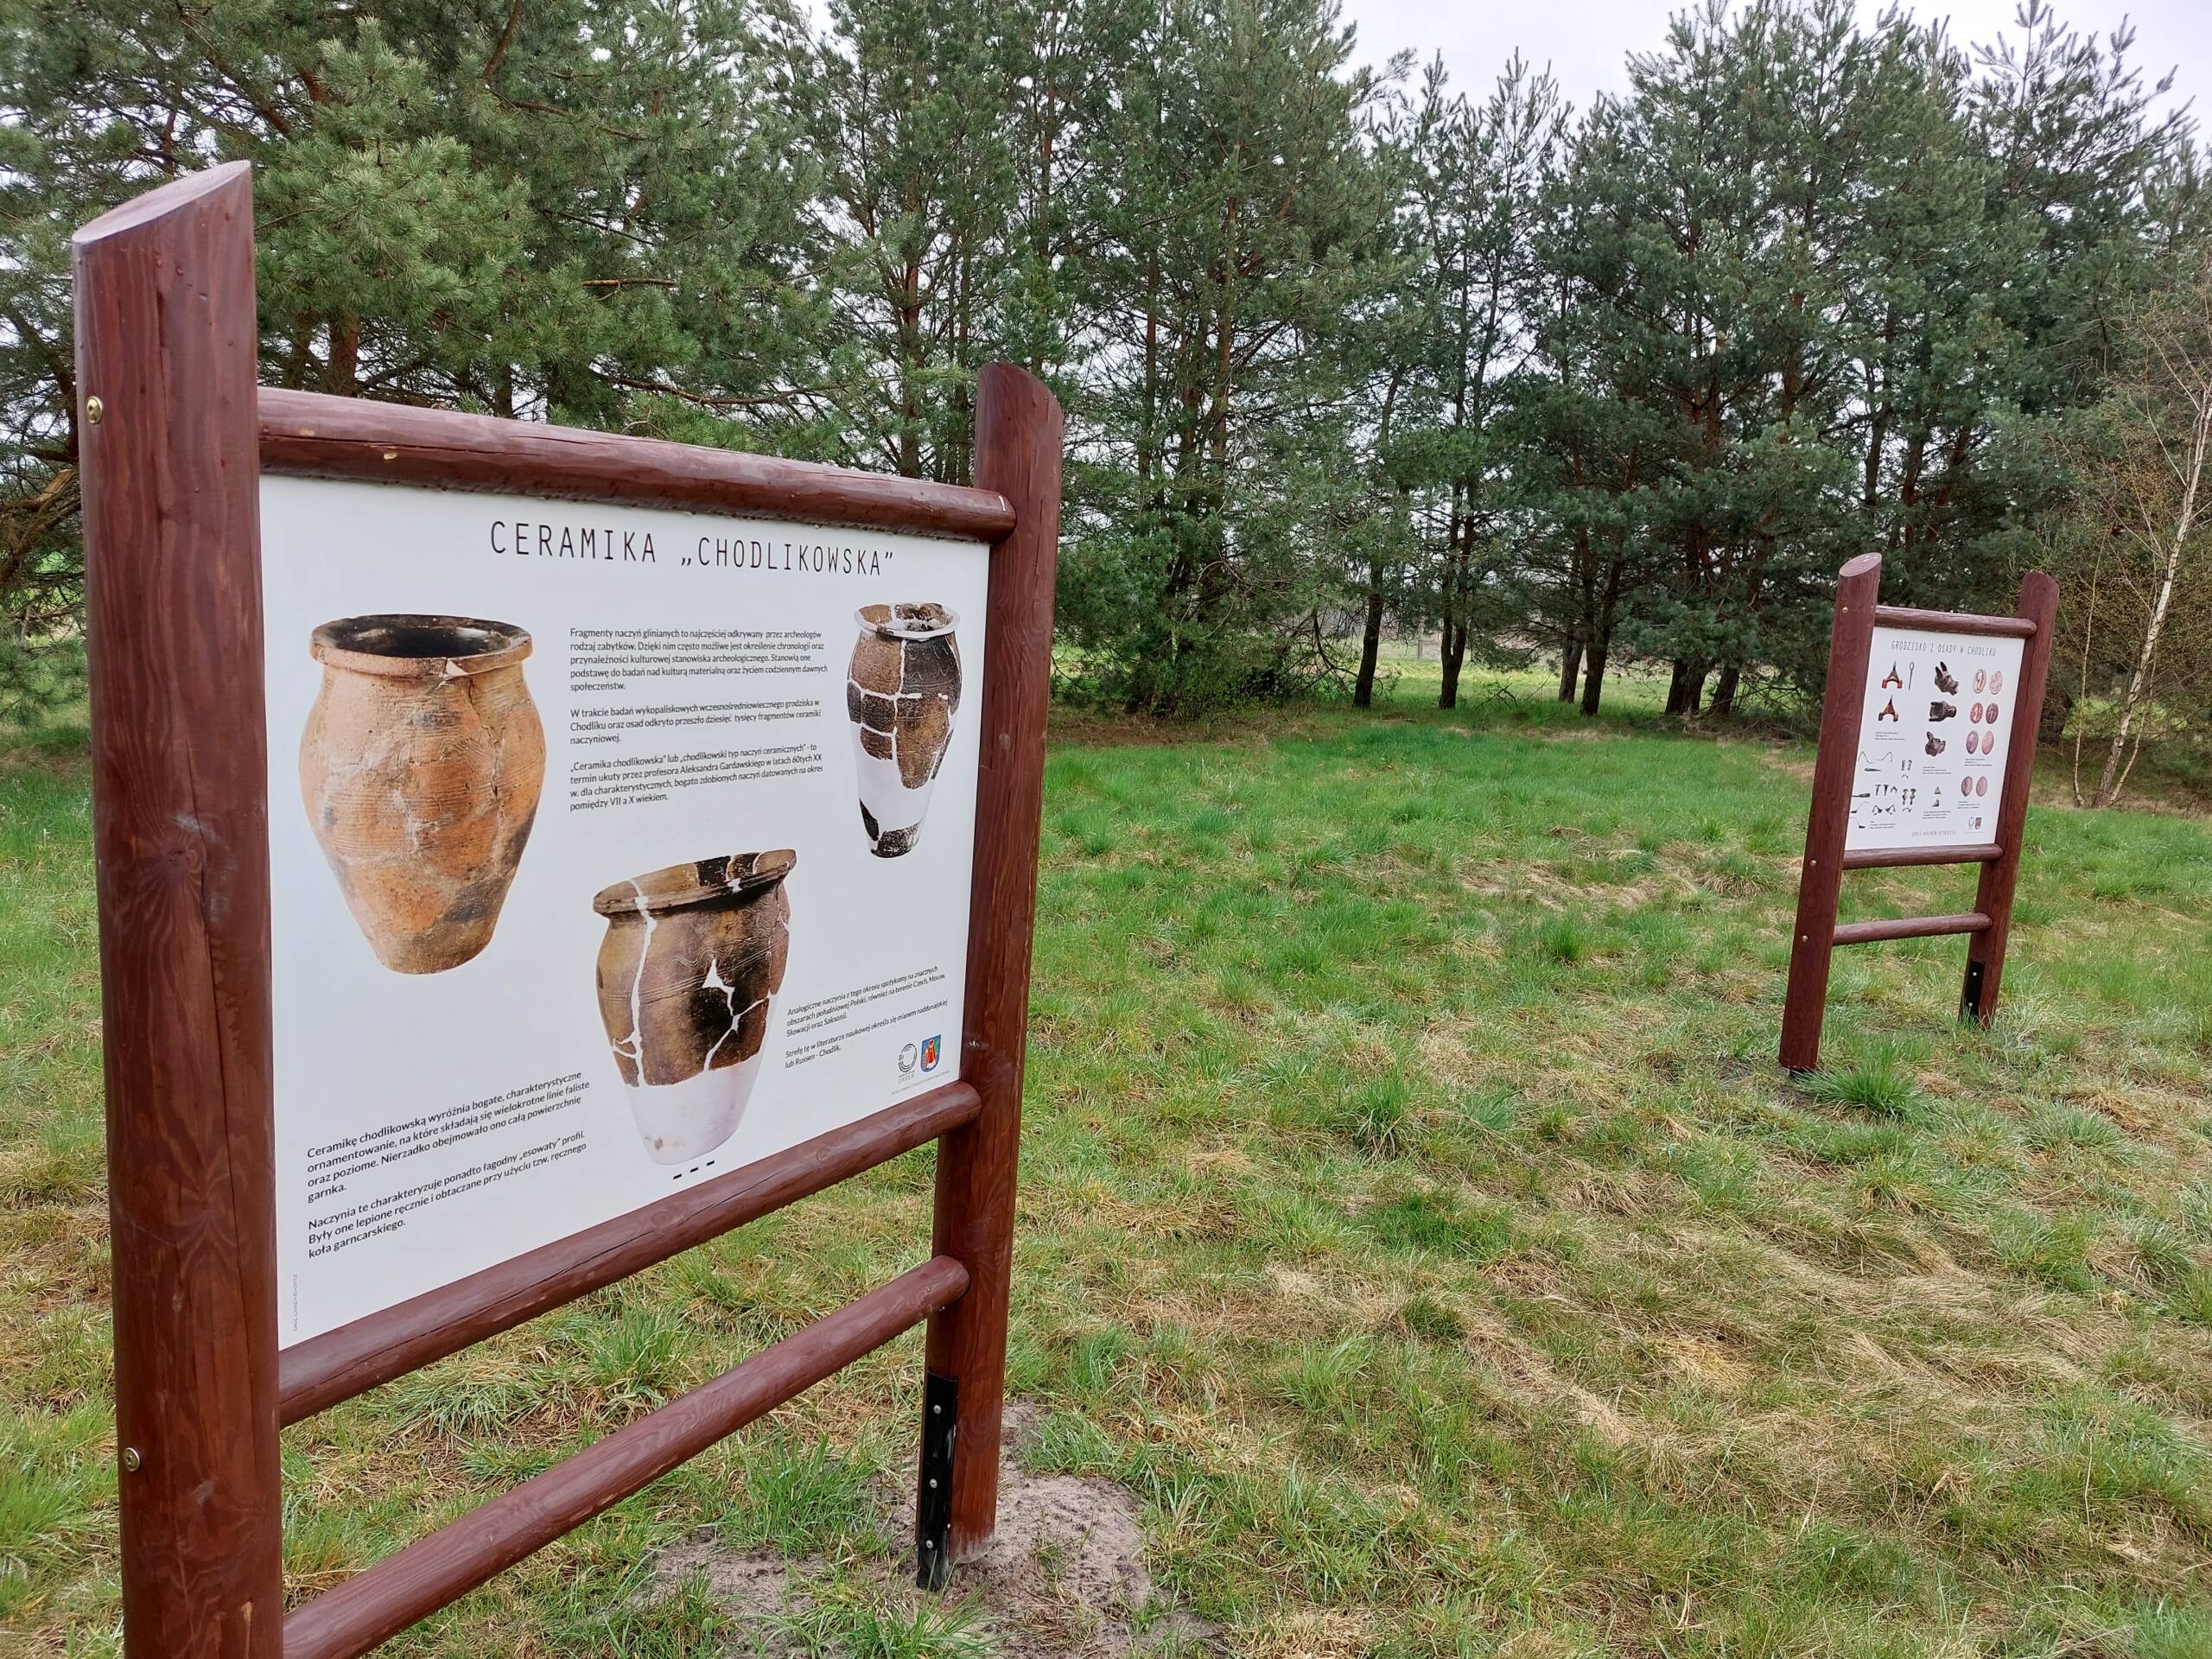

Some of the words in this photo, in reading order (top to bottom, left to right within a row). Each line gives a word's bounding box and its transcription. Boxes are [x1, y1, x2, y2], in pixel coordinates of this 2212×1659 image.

[491, 520, 656, 563] CERAMIKA
[681, 537, 893, 576] „CHODLIKOWSKA”
[570, 627, 613, 639] Fragmenty
[614, 628, 642, 639] naczyń
[642, 628, 680, 639] glinianych
[690, 629, 727, 639] najczęściej
[727, 629, 764, 639] odkrywany
[783, 630, 823, 640] archeologów
[569, 641, 596, 652] rodzaj
[597, 641, 636, 652] zabytków.
[638, 641, 661, 652] Dzięki
[662, 641, 677, 651] nim
[677, 642, 700, 652] często
[701, 641, 729, 651] możliwe
[729, 641, 742, 652] jest
[742, 641, 777, 651] określenie
[777, 641, 811, 652] chronologii
[1891, 640, 1927, 652] GRODZISKO
[570, 654, 629, 666] przynależności
[630, 654, 671, 664] kulturowej
[671, 653, 711, 664] stanowiska
[711, 653, 770, 664] archeologicznego.
[771, 653, 799, 663] Stanowią
[569, 669, 609, 680] podstawę
[610, 667, 621, 677] do
[621, 667, 645, 677] badań
[646, 667, 661, 677] nad
[661, 666, 688, 677] kulturą
[688, 665, 726, 676] materialną
[741, 665, 765, 676] życiem
[765, 665, 802, 674] codziennym
[802, 664, 829, 674] dawnych
[569, 709, 581, 718] W
[582, 708, 609, 718] trakcie
[610, 706, 634, 716] badań
[635, 703, 699, 716] wykopaliskowych
[699, 701, 785, 712] wczesnośredniowiecznego
[785, 698, 814, 709] grodziska
[569, 721, 607, 732] Chodliku
[626, 719, 644, 728] osad
[645, 717, 674, 728] odkryto
[675, 715, 705, 727] przeszło
[705, 714, 732, 724] dziesięć
[734, 713, 758, 723] tysięcy
[758, 710, 796, 721] fragmentów
[796, 709, 822, 718] ceramiki
[570, 733, 621, 746] naczyniowej.
[667, 753, 679, 763] lub
[740, 747, 762, 757] naczyń
[569, 773, 597, 785] termin
[598, 772, 621, 782] ukuty
[622, 772, 643, 781] przez
[644, 767, 679, 779] profesora
[679, 762, 719, 774] Aleksandra
[719, 760, 766, 771] Gardawskiego
[772, 756, 791, 766] latach
[791, 754, 813, 764] 60tych
[580, 787, 593, 797] dla
[594, 779, 673, 796] charakterystycznych,
[674, 778, 699, 788] bogato
[699, 772, 738, 785] zdobionych
[738, 770, 761, 780] naczyń
[760, 766, 798, 779] datowanych
[806, 765, 823, 773] okres
[569, 798, 609, 812] pomiędzy
[609, 797, 621, 806] VII
[635, 793, 669, 803] wiekiem.
[307, 1137, 358, 1158] Ceramikę
[359, 1117, 427, 1143] chodlikowską
[428, 1103, 471, 1122] wyróżnia
[505, 1072, 582, 1100] charakterystyczne
[307, 1140, 397, 1173] ornamentowanie,
[399, 1135, 411, 1146] na
[413, 1128, 439, 1141] które
[440, 1115, 479, 1133] składają
[480, 1110, 493, 1122] się
[493, 1096, 545, 1116] wielokrotne
[546, 1089, 564, 1101] linie
[565, 1082, 590, 1095] faliste
[308, 1173, 331, 1187] oraz
[333, 1160, 379, 1182] poziome.
[381, 1143, 430, 1165] Nierzadko
[432, 1125, 488, 1148] obejmowało
[489, 1120, 506, 1130] ono
[507, 1113, 526, 1125] całą
[527, 1096, 582, 1121] powierzchnię
[308, 1208, 356, 1230] Naczynia
[359, 1205, 369, 1213] te
[370, 1179, 442, 1210] charakteryzuje
[443, 1166, 481, 1186] ponadto
[483, 1154, 518, 1172] łagodny
[562, 1130, 585, 1147] profil.
[308, 1184, 346, 1204] garnka.
[308, 1230, 333, 1245] Były
[334, 1223, 354, 1236] one
[356, 1210, 393, 1229] lepione
[394, 1197, 429, 1215] ręcznie
[435, 1179, 482, 1201] obtaczane
[483, 1172, 503, 1186] przy
[504, 1161, 531, 1177] użyciu
[532, 1156, 550, 1167] tzw.
[550, 1143, 587, 1161] ręcznego
[308, 1244, 332, 1259] koła
[334, 1219, 406, 1252] garncarskiego.
